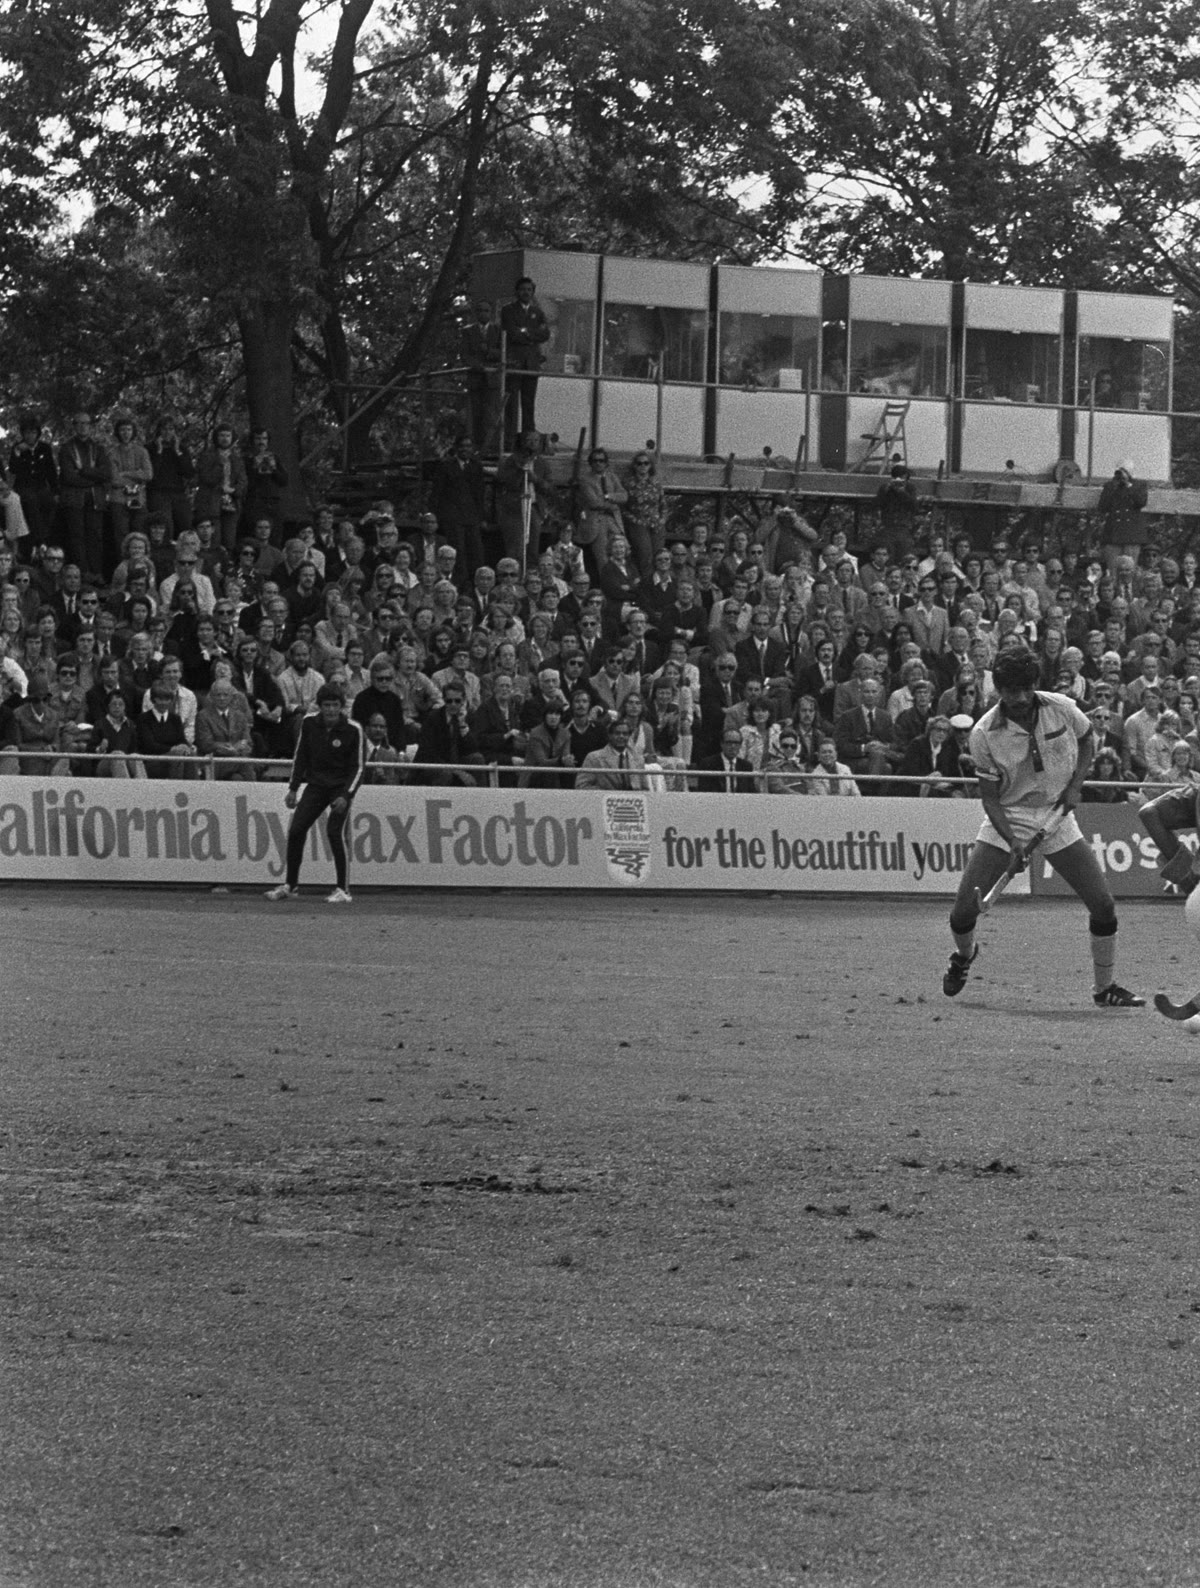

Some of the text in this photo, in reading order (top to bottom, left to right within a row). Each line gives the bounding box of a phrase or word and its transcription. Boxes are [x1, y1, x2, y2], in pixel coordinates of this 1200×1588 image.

[235, 795, 294, 877] by
[426, 799, 594, 867] Factor
[662, 827, 711, 869] for
[714, 828, 766, 870] the
[772, 829, 906, 871] beautiful
